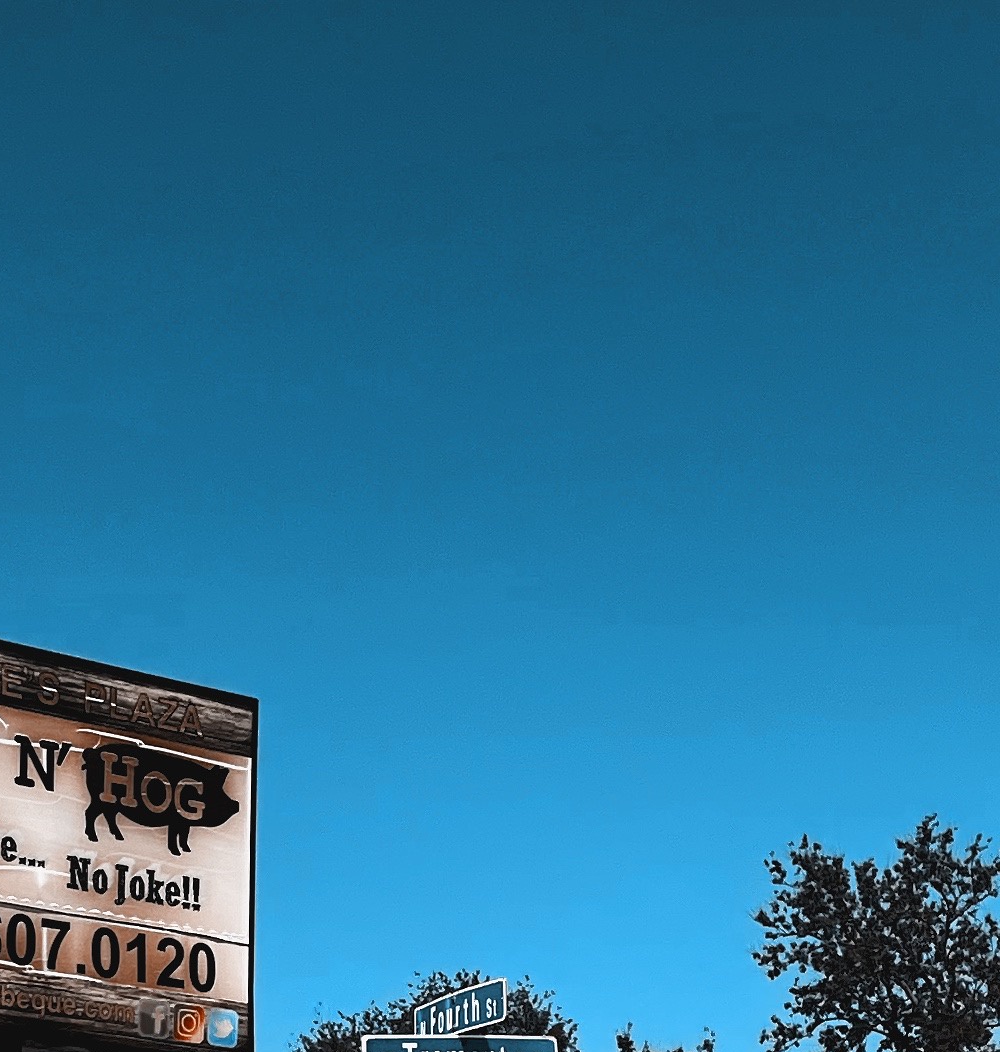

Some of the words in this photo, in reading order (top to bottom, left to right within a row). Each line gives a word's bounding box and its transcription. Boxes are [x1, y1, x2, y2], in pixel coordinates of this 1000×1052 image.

[84, 681, 204, 738] PLAZA
[100, 751, 206, 820] HOG
[66, 853, 109, 896] No
[114, 864, 201, 912] Joke!!
[430, 992, 480, 1035] Fourth
